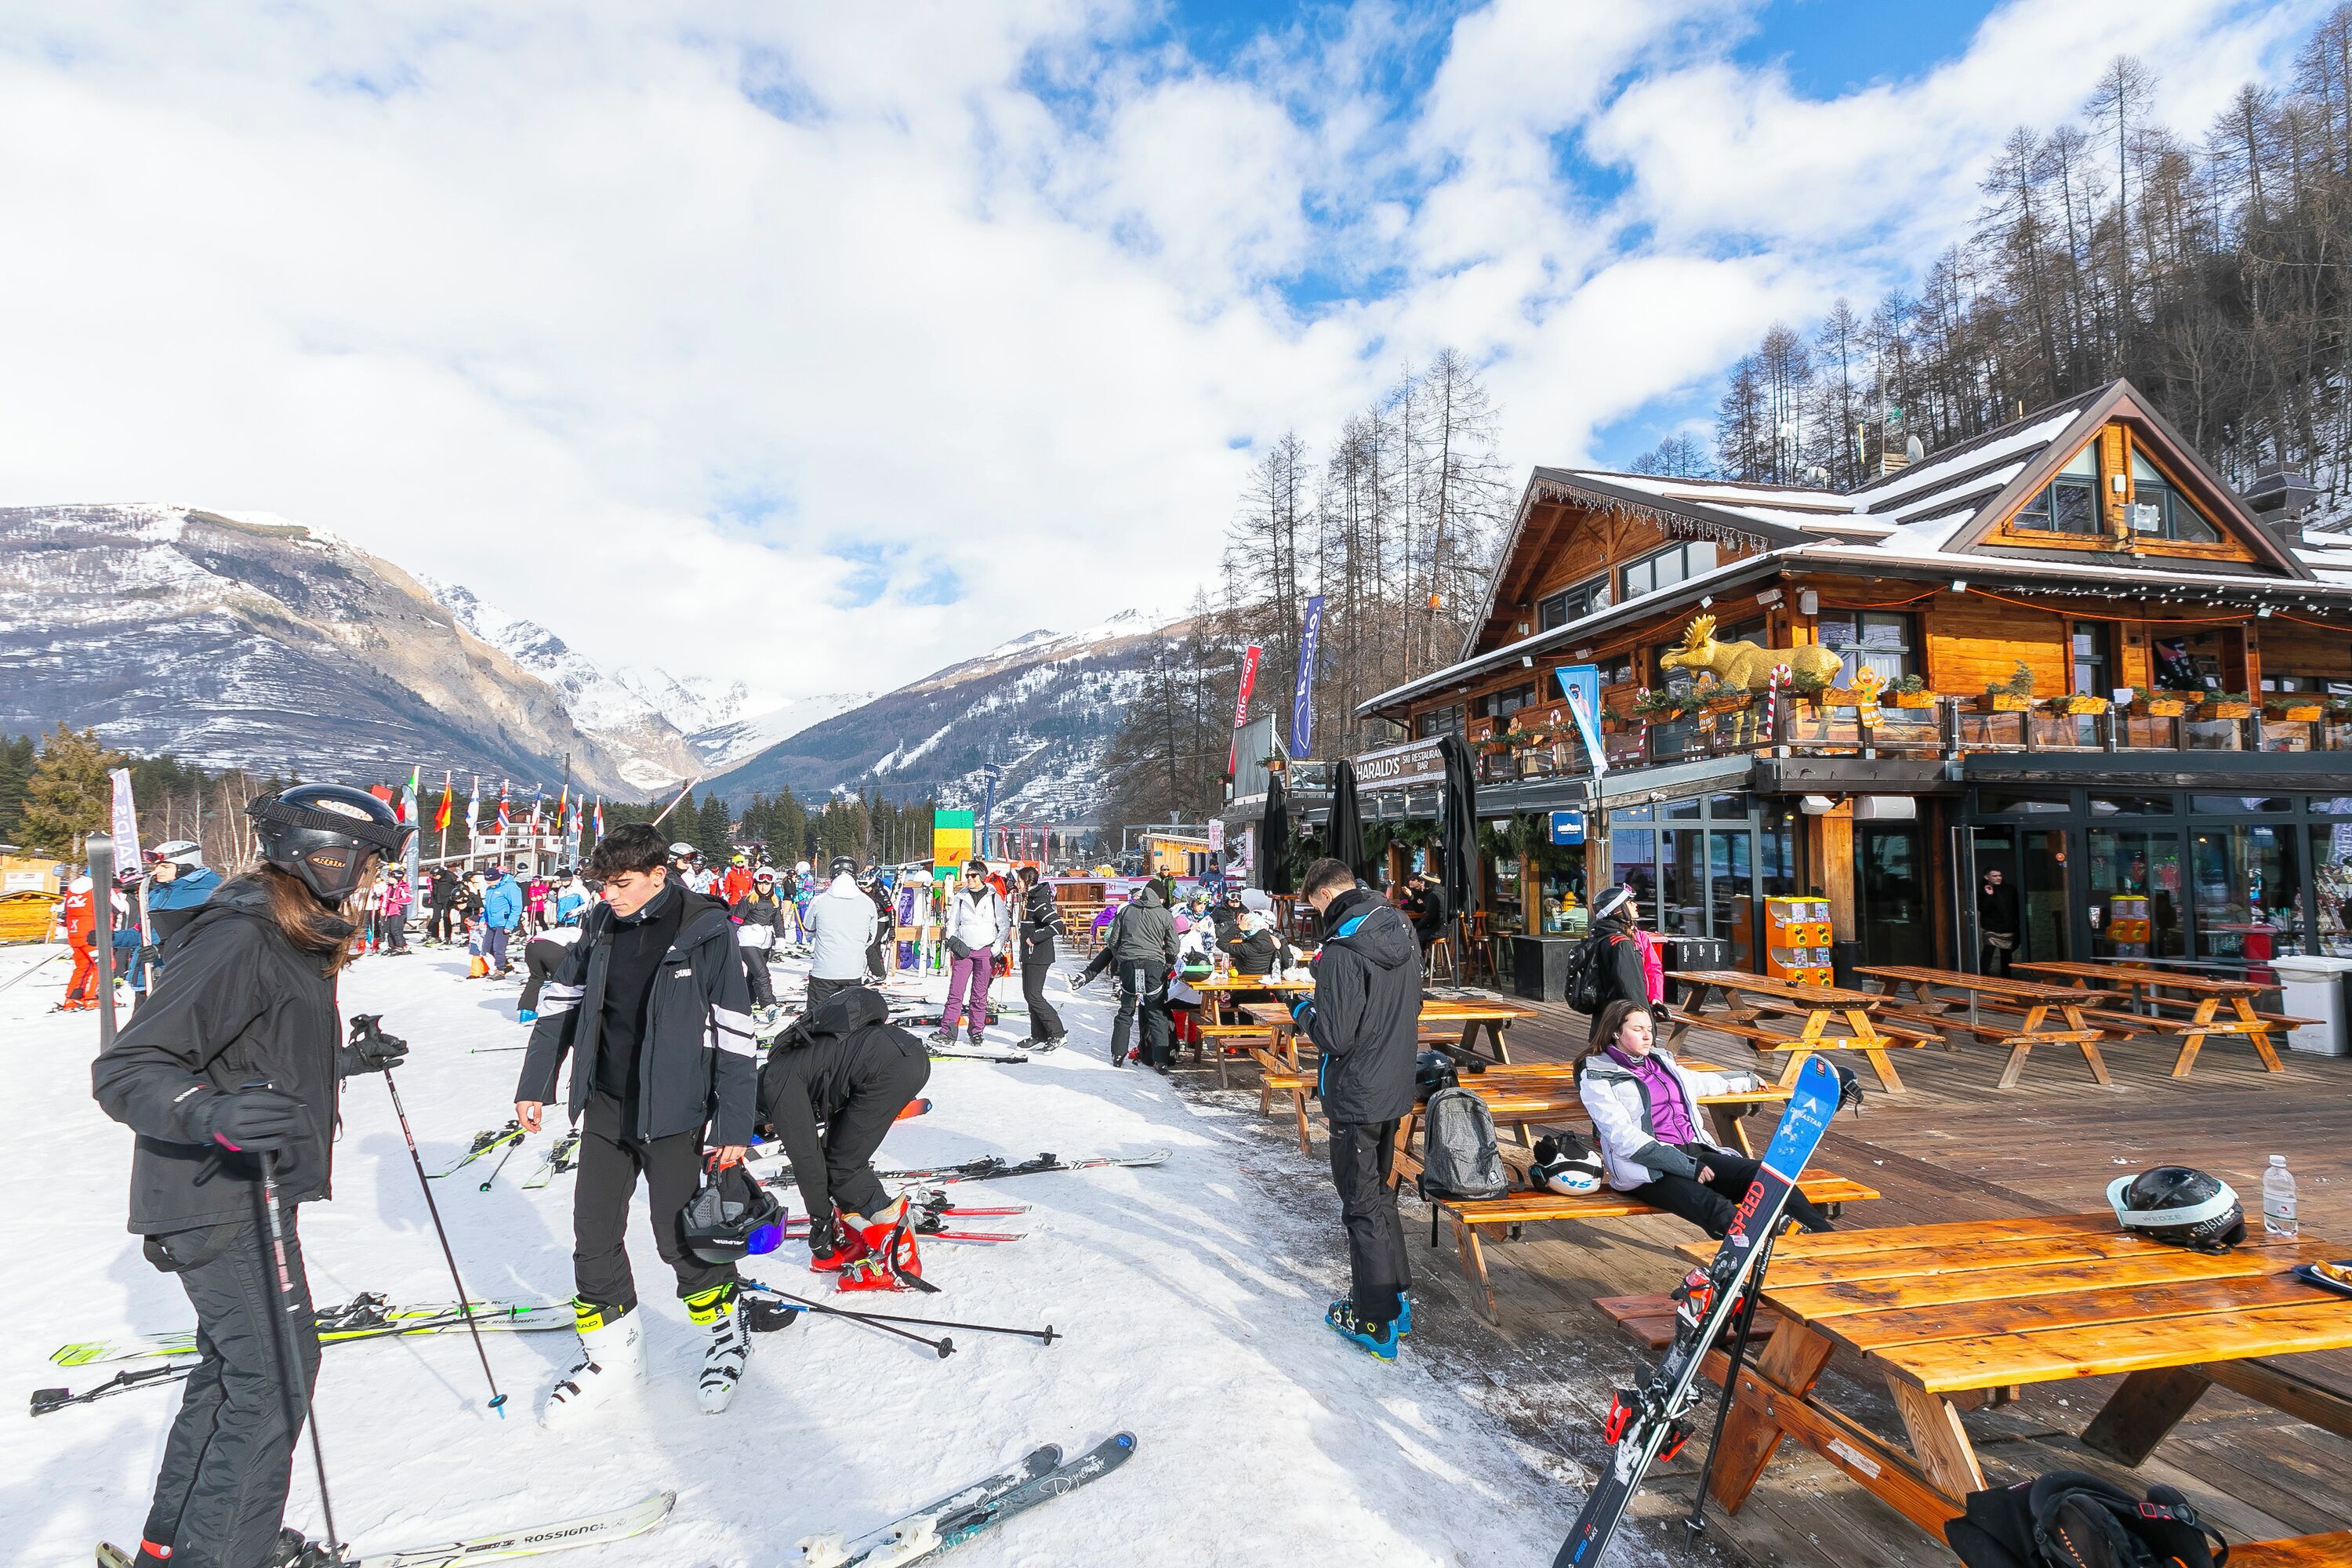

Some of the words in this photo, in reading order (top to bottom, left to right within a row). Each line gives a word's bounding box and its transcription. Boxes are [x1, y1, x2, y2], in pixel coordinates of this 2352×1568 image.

[1236, 695, 1246, 728] ardo
[1356, 757, 1400, 782] HARALD'S
[1402, 754, 1410, 764] SKI
[1411, 749, 1443, 763] RESTAURAN
[1417, 760, 1429, 771] BAR
[1727, 1181, 1765, 1236] SPEED
[1573, 1539, 1588, 1563] SPEED
